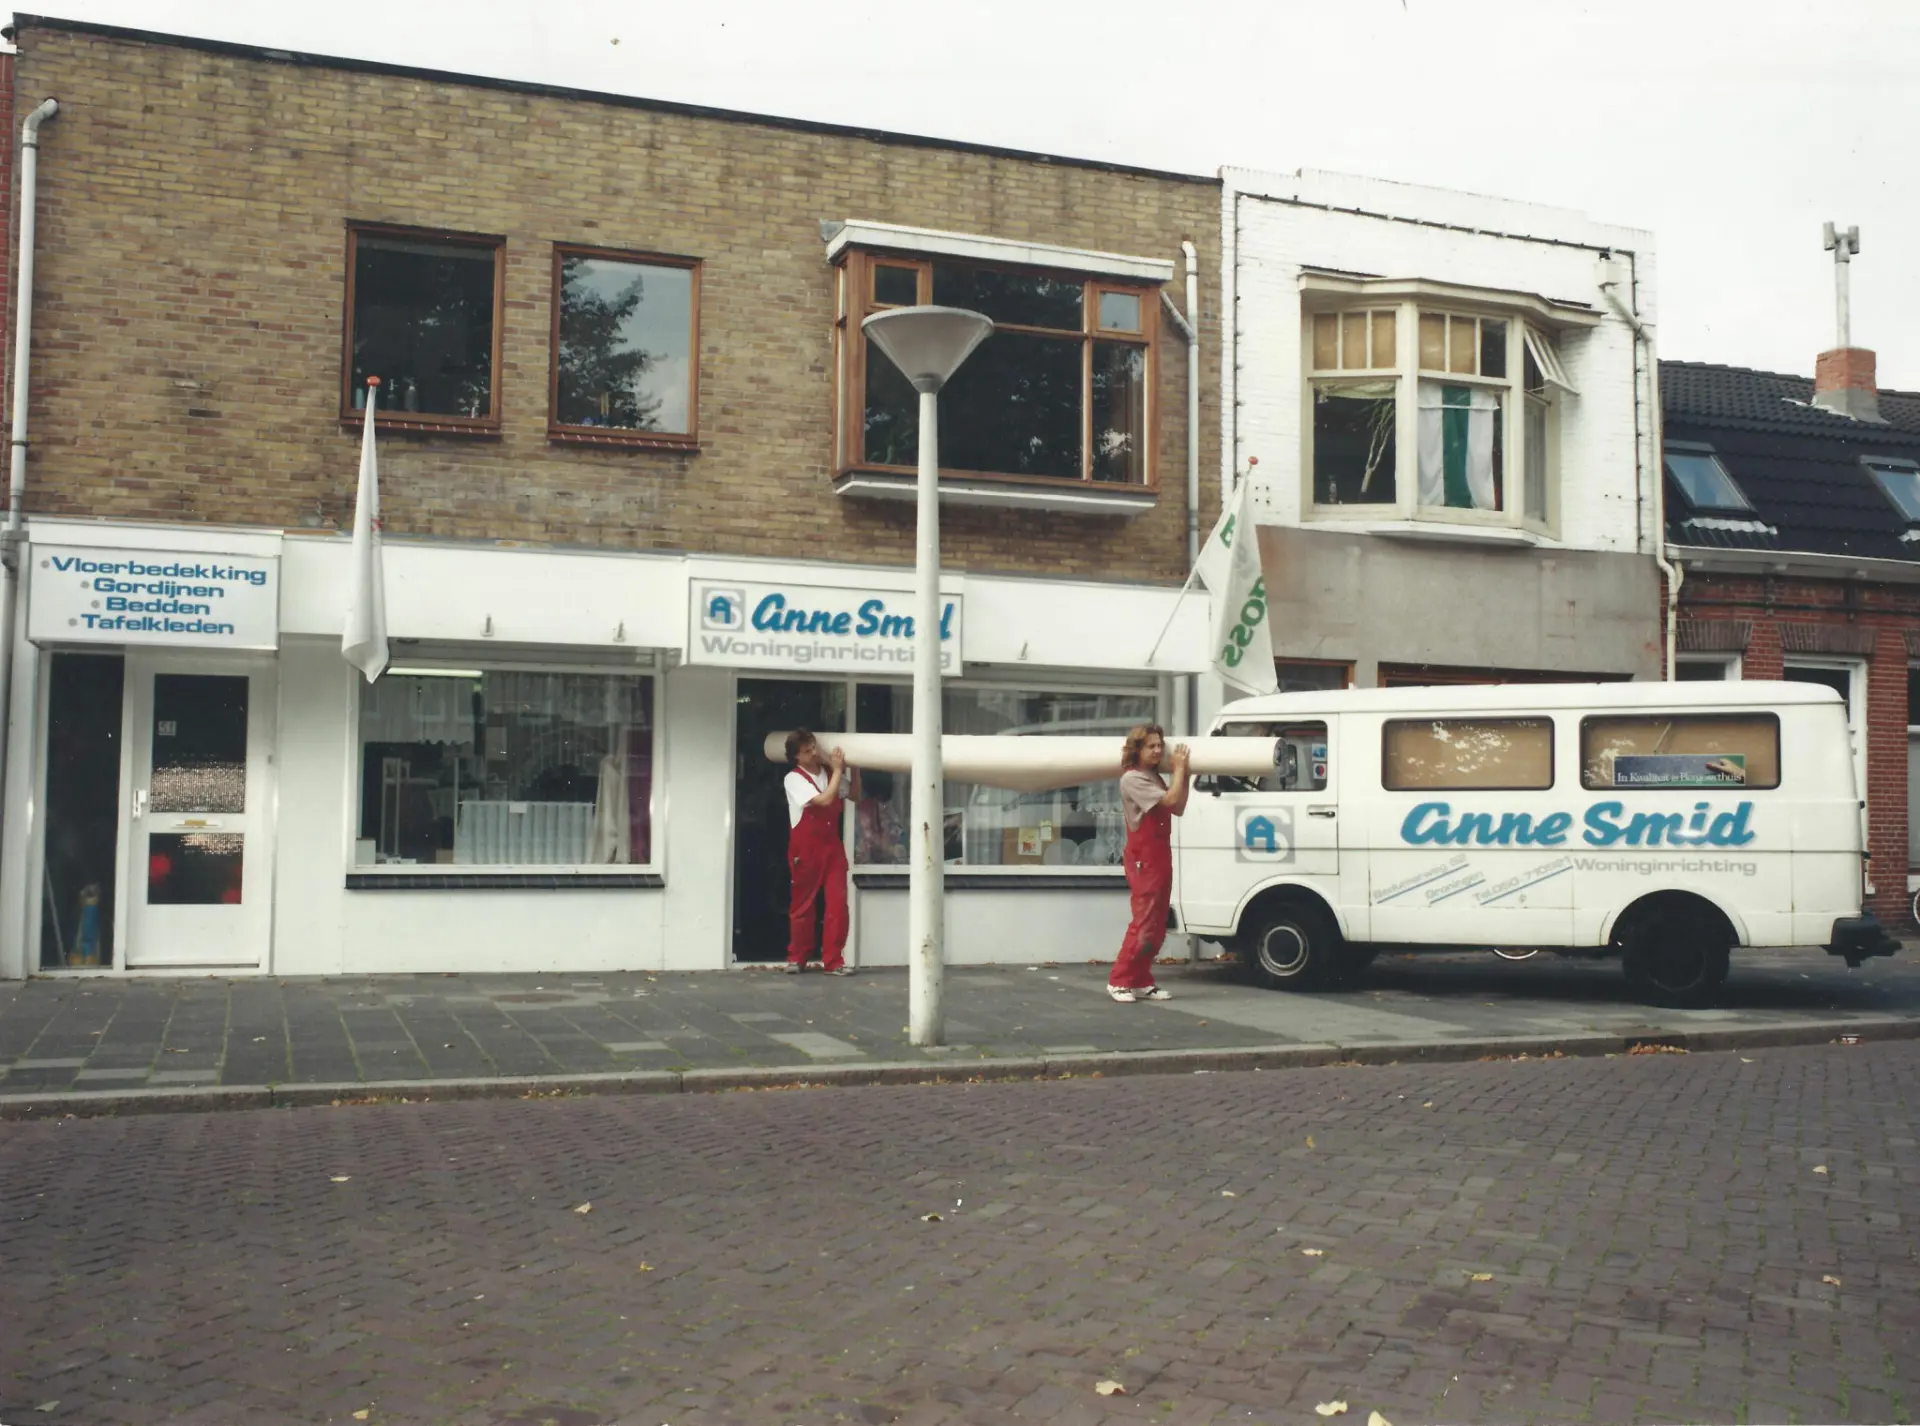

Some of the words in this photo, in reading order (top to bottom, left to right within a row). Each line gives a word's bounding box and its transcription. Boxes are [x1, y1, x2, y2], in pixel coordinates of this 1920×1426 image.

[51, 556, 267, 586] Vloerbedekking
[93, 577, 225, 598] Gordijnen
[105, 596, 211, 615] Bedden
[80, 613, 235, 634] Tafelkleden
[701, 635, 951, 669] Woninginrichtig
[1582, 800, 1756, 848] Smid
[1574, 857, 1758, 876] Woninginrichting
